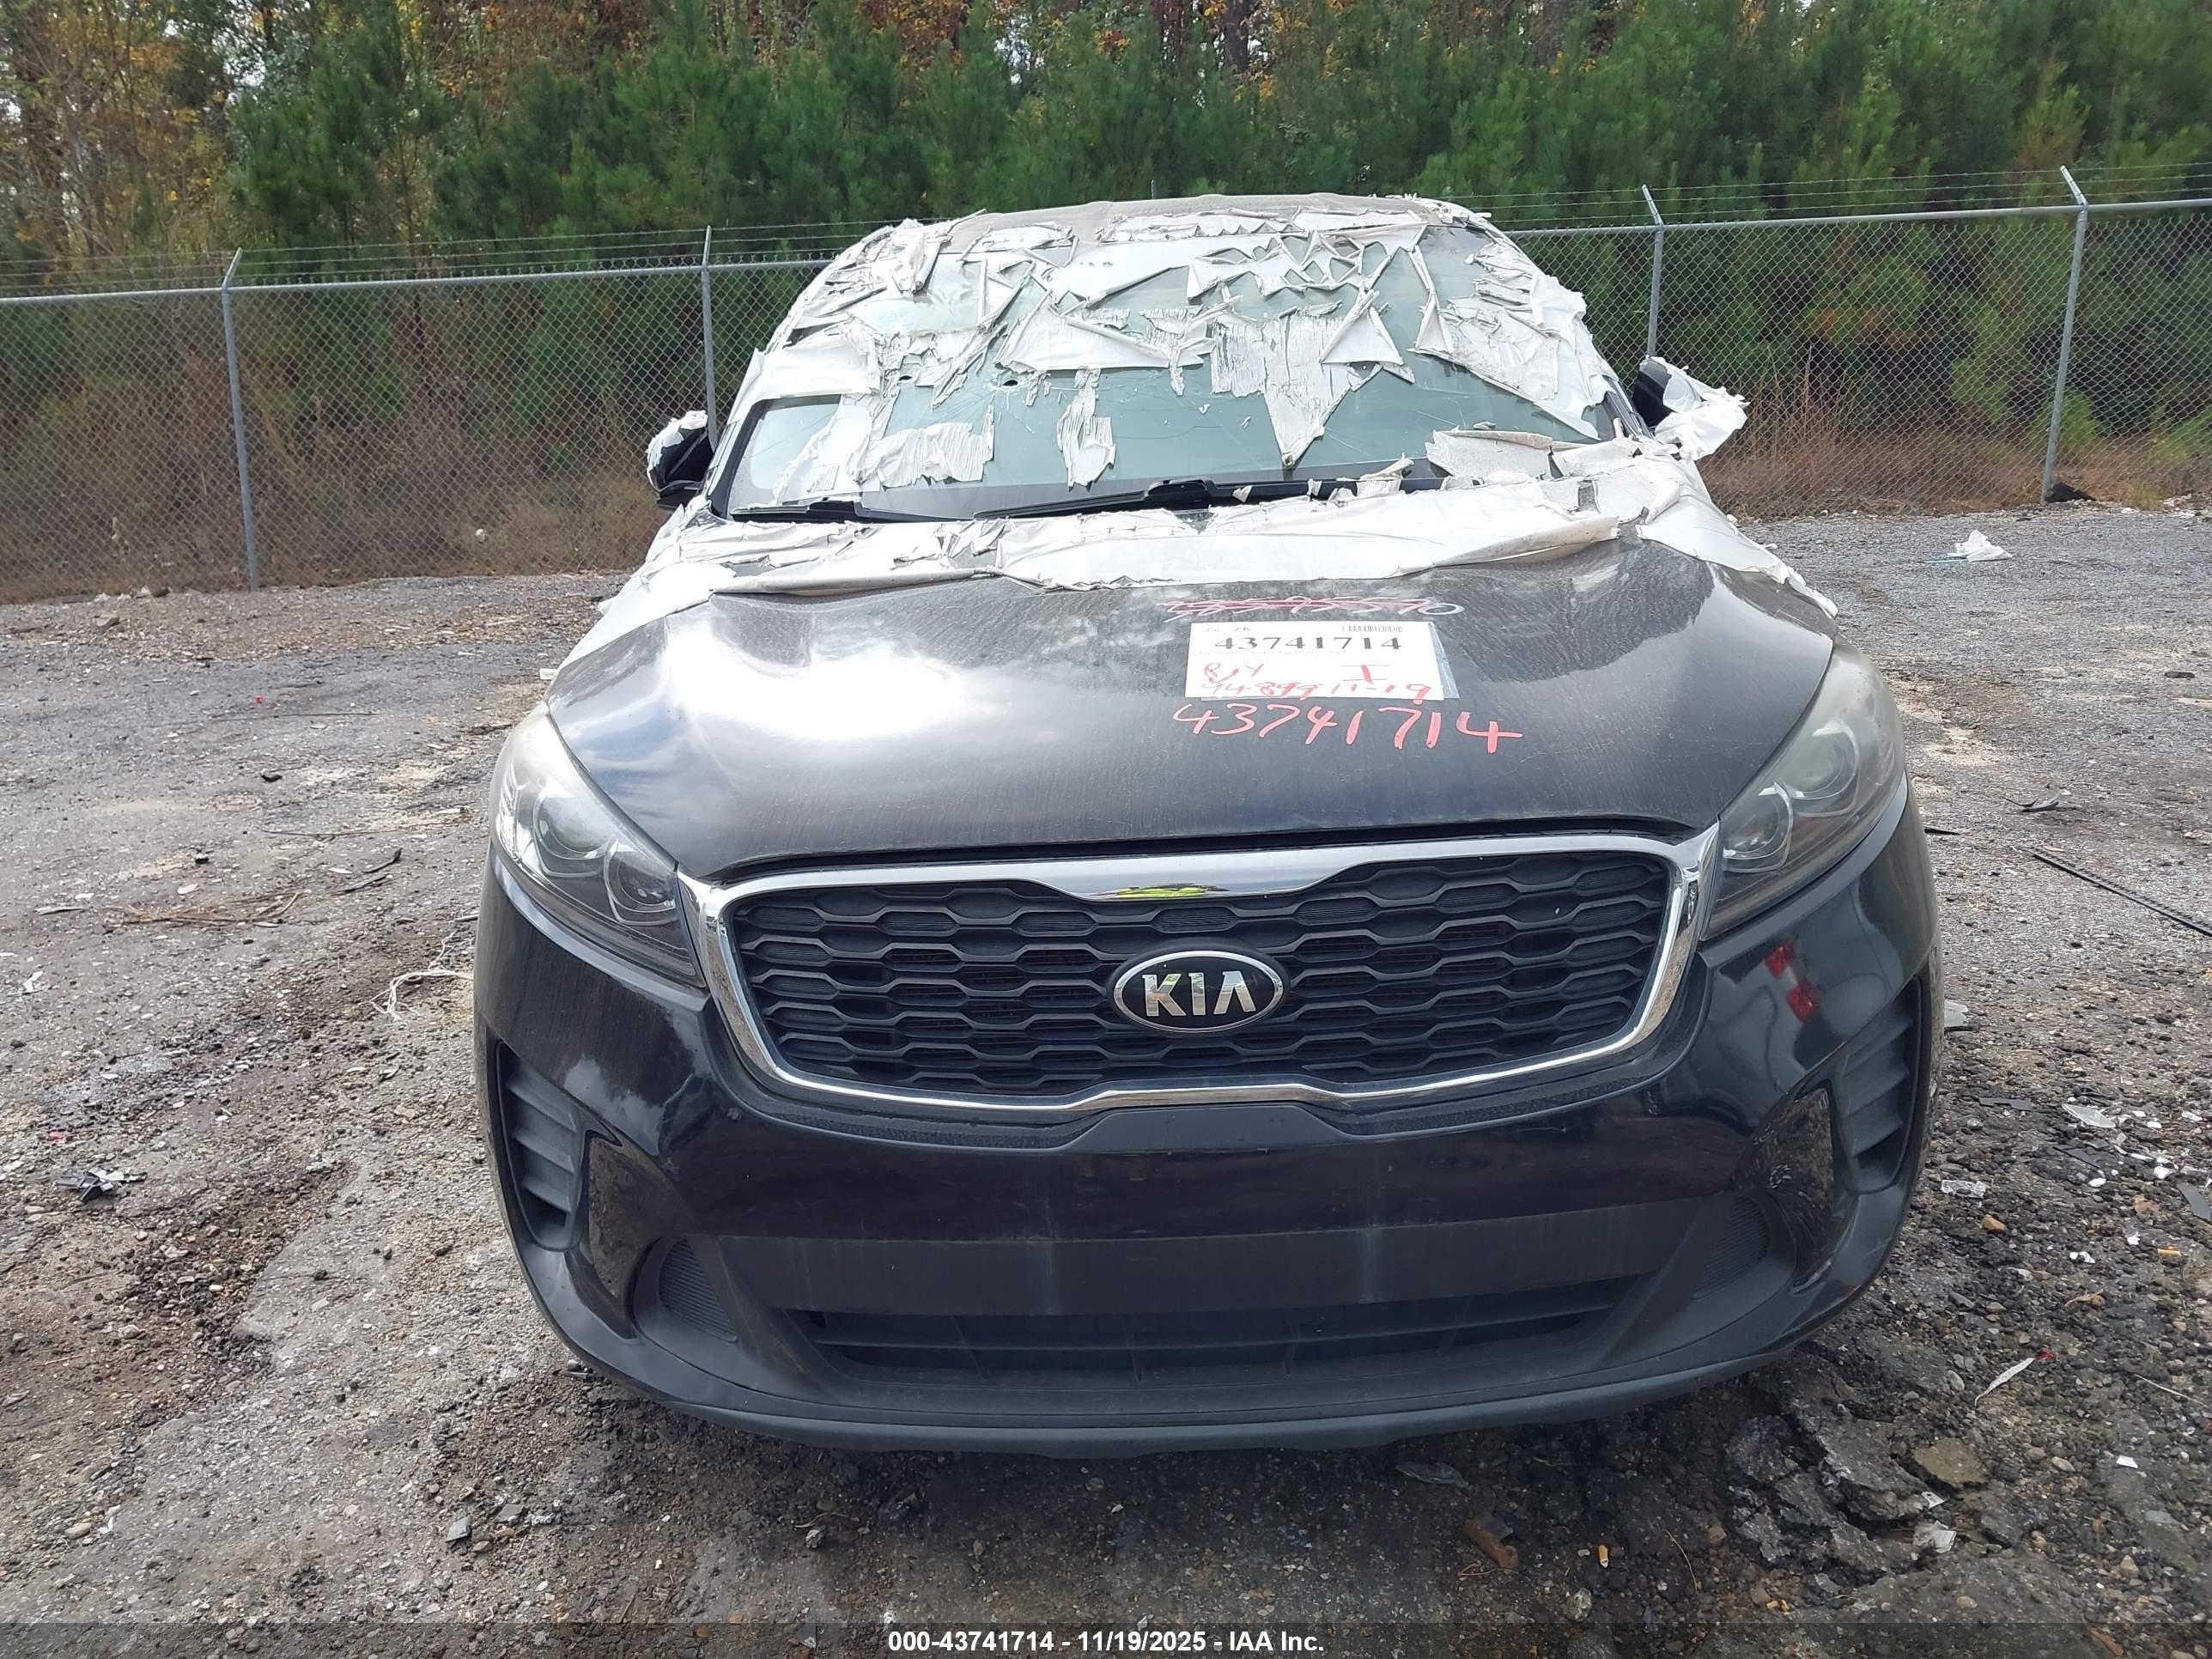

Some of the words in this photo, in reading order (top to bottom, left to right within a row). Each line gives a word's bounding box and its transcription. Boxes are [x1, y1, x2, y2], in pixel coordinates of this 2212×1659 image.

[1214, 636, 1402, 651] 43741714
[1173, 702, 1524, 755] 43741714
[1141, 970, 1257, 1017] KIA
